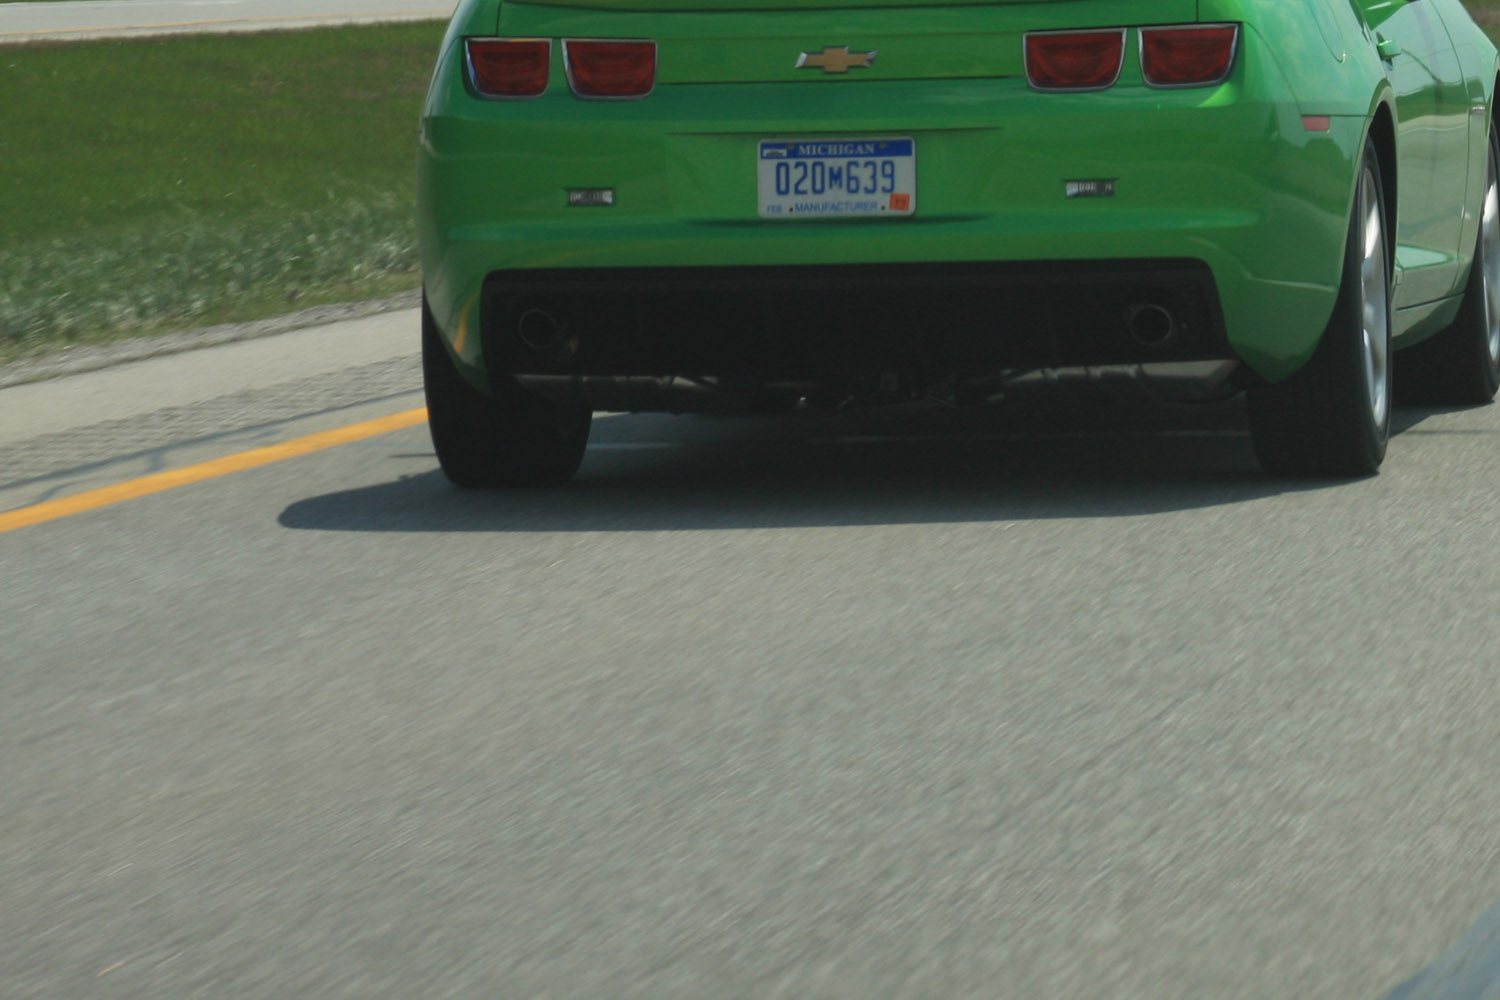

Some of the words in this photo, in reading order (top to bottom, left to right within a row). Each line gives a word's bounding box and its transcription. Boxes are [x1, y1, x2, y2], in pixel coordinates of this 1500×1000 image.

[798, 143, 875, 156] MICHIGAN
[775, 159, 896, 196] 020M639
[794, 201, 878, 213] MANUFACTURER
